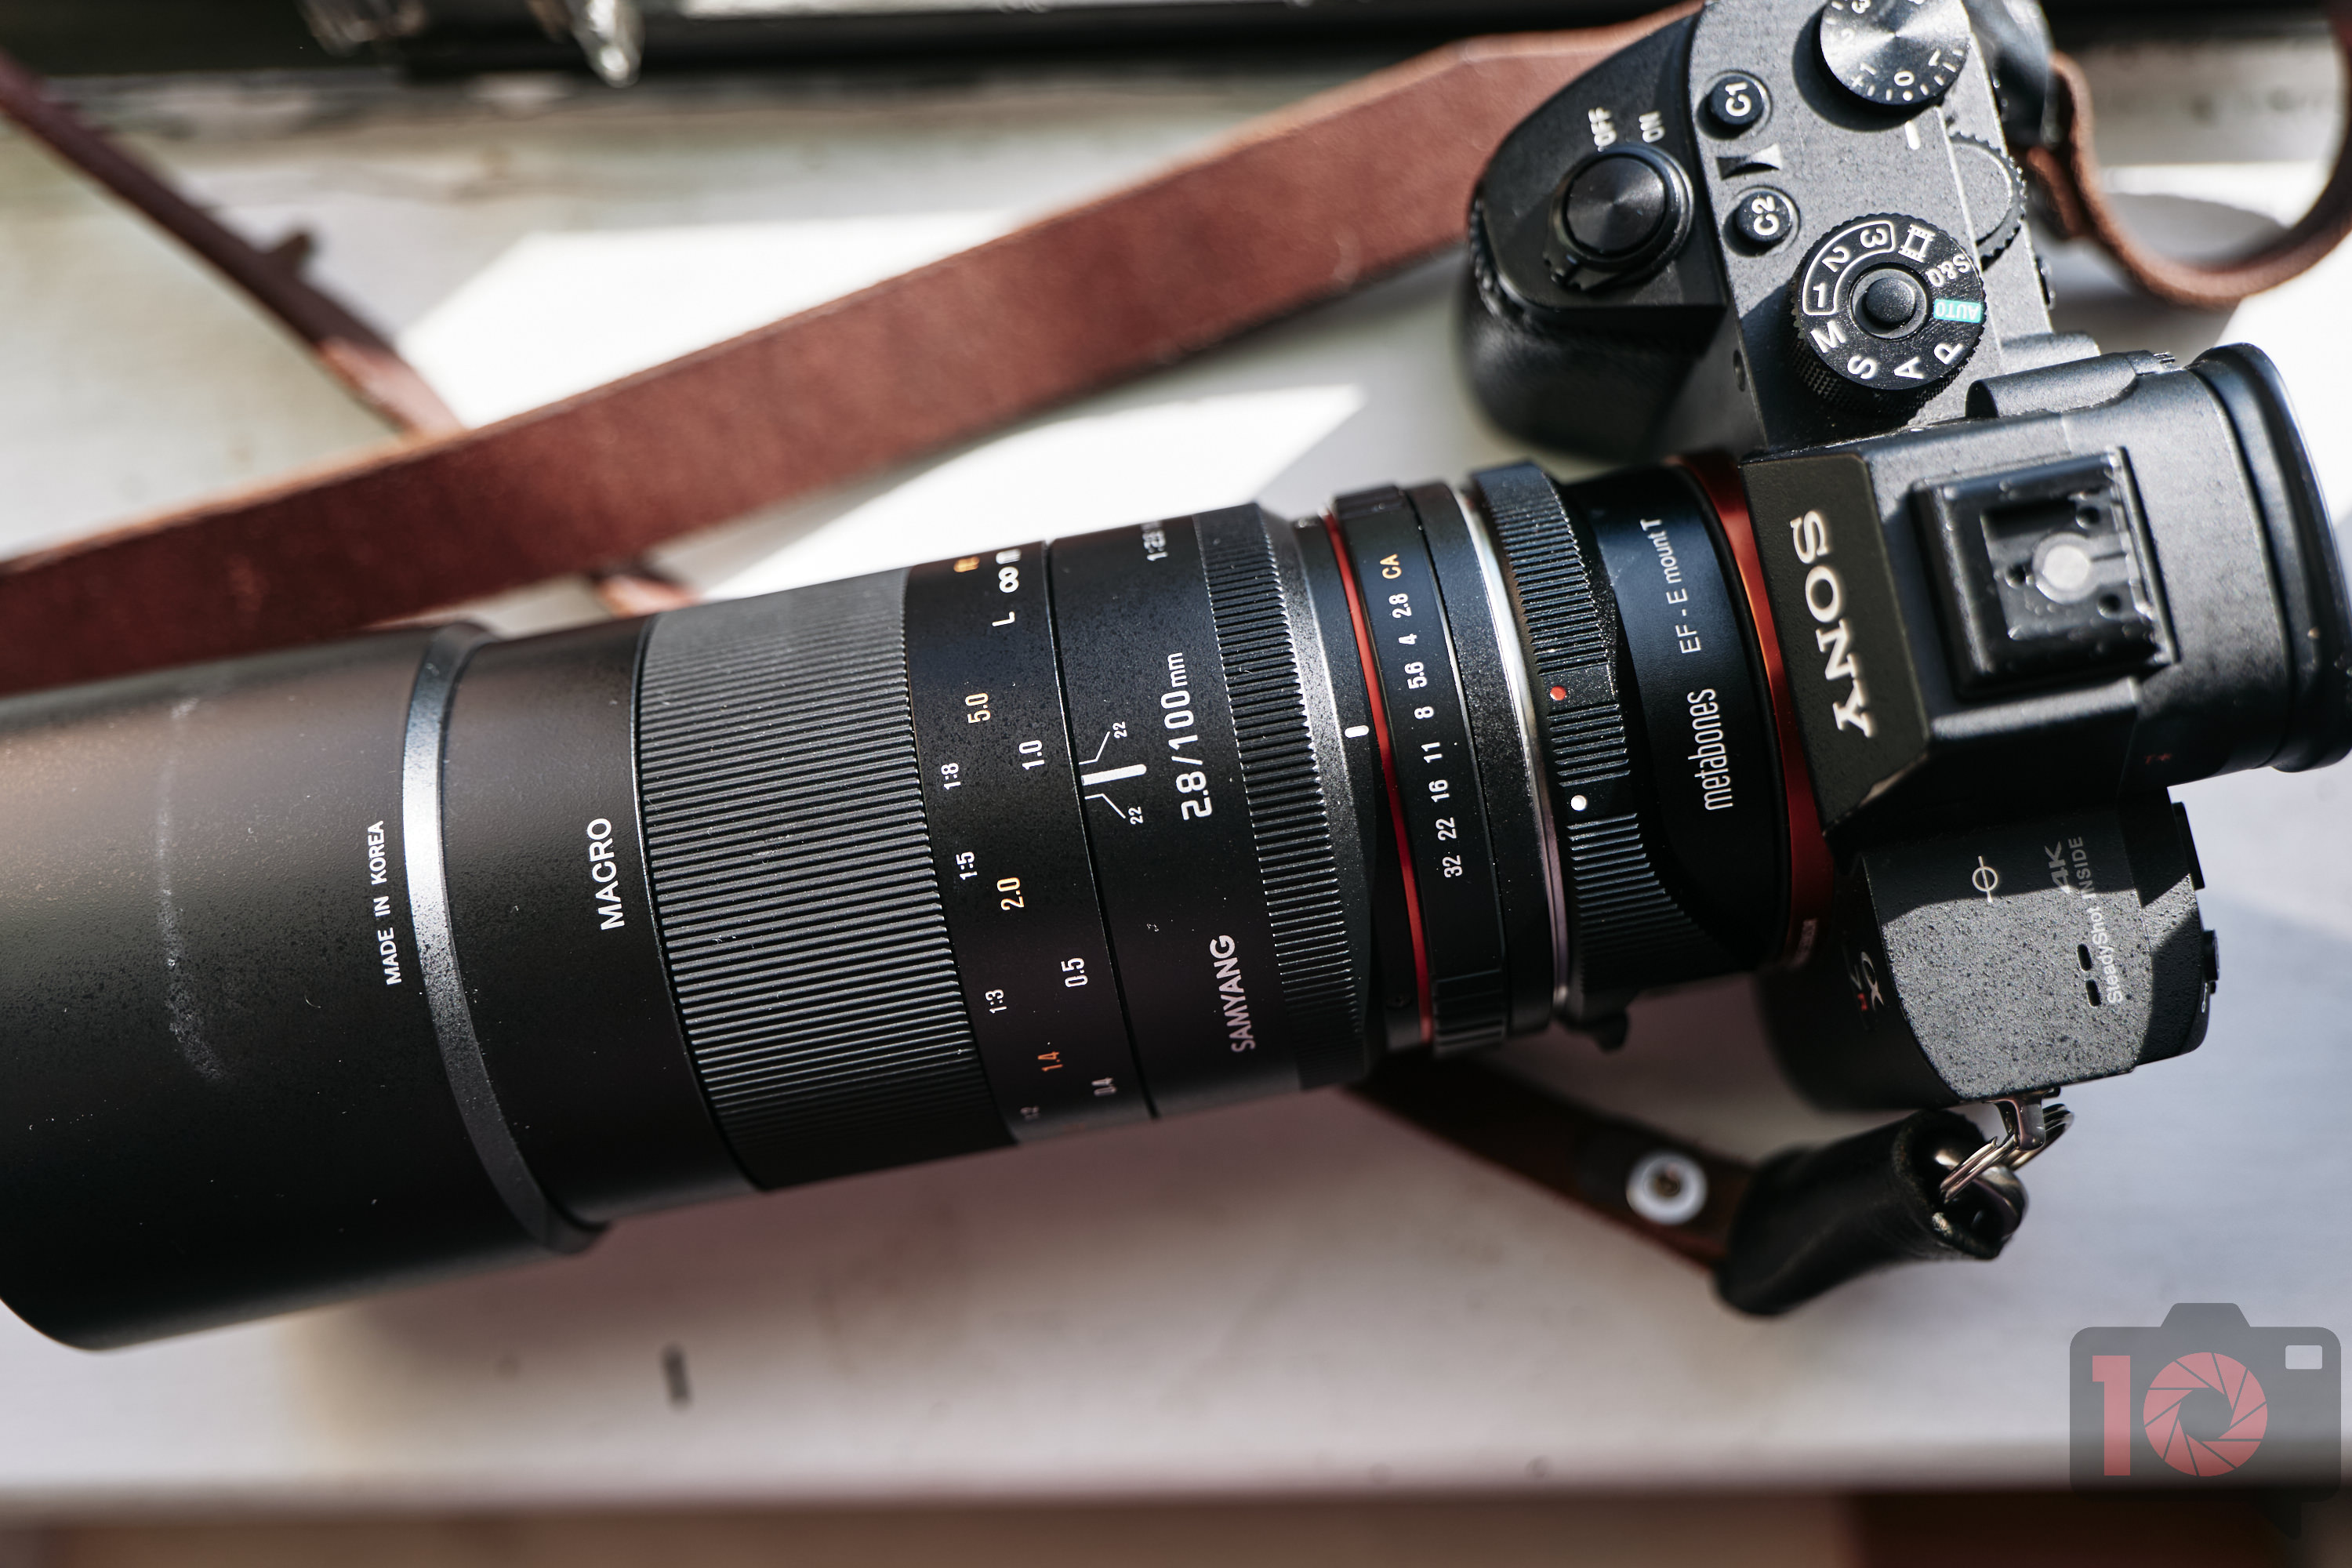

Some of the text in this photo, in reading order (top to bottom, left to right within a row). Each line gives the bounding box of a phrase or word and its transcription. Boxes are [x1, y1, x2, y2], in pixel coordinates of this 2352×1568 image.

[1893, 71, 1915, 87] 0
[1725, 82, 1752, 117] C1
[1588, 107, 1617, 147] OFF
[1639, 112, 1664, 143] ON
[1751, 195, 1780, 236] C2
[1860, 227, 1888, 249] 3
[1822, 245, 1850, 273] 2
[1812, 282, 1827, 309] 1
[1935, 301, 1980, 320] AUTO
[1810, 320, 1846, 354] M
[1846, 354, 1878, 380] S
[1893, 356, 1925, 379] A
[1933, 343, 1964, 365] P
[1639, 519, 1661, 532] T
[1647, 531, 1682, 584] mount
[1388, 593, 1412, 619] 2.8
[1665, 588, 1688, 604] E
[1790, 510, 1873, 738] SONY
[1398, 633, 1417, 645] 4
[1675, 624, 1701, 654] EF
[1404, 661, 1428, 690] 5.6
[1414, 706, 1435, 720] 8
[1112, 720, 1127, 739] 22
[1018, 739, 1045, 771] 1.0
[1421, 742, 1443, 764] 11
[1686, 688, 1733, 811] metabones
[940, 762, 961, 790] 1:8
[1428, 779, 1450, 803] 16
[1128, 806, 1144, 825] 22
[1436, 817, 1457, 841] 22
[586, 818, 625, 931] MACRO
[955, 851, 978, 880] 1:5
[1442, 855, 1463, 878] 32
[2044, 840, 2071, 895] 4K
[964, 692, 1063, 1072] 1.4 2.0 5.0
[367, 820, 402, 985] MADE IN KOREA
[2067, 836, 2124, 1004] SteadyShot INSIDE
[1060, 957, 1088, 988] 0.5
[985, 989, 1007, 1014] 1:3
[1209, 935, 1255, 1051] SAMYANG
